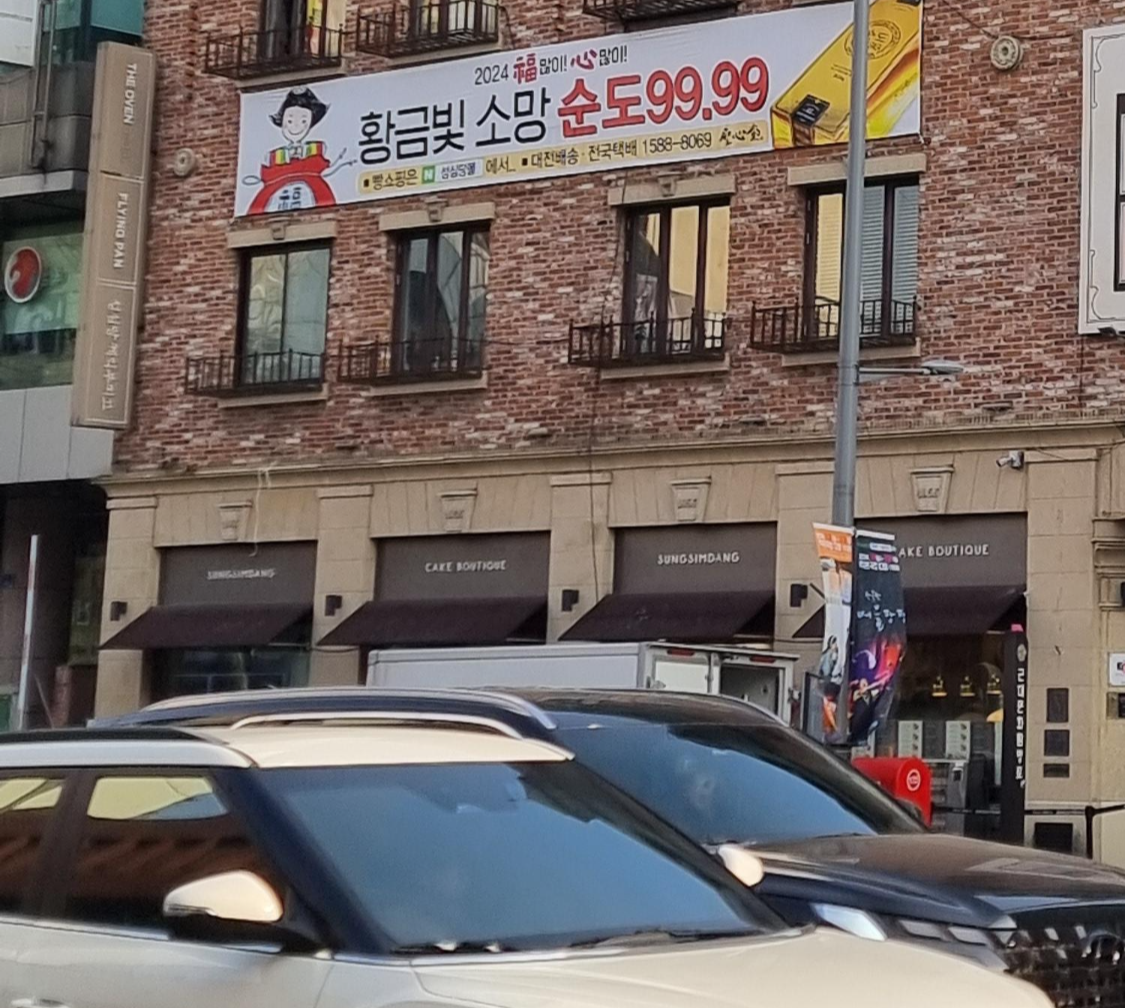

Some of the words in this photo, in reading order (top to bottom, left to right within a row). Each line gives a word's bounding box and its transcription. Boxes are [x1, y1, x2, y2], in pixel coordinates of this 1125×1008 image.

[125, 63, 137, 87] THE
[474, 64, 509, 86] 2024
[122, 88, 136, 125] OVEN
[358, 99, 466, 166] 황금빛
[475, 87, 552, 148] 소망
[557, 57, 770, 138] 순도99.99
[371, 168, 418, 191] 빵쇼핑은
[115, 192, 128, 239] FLYING
[113, 241, 126, 269] PAN
[656, 550, 741, 565] SUNGSIMDANG
[898, 545, 924, 558] AKE
[928, 543, 990, 558] BOUTIQUE
[424, 561, 452, 573] CAKE
[456, 559, 508, 572] BOUTIQUE
